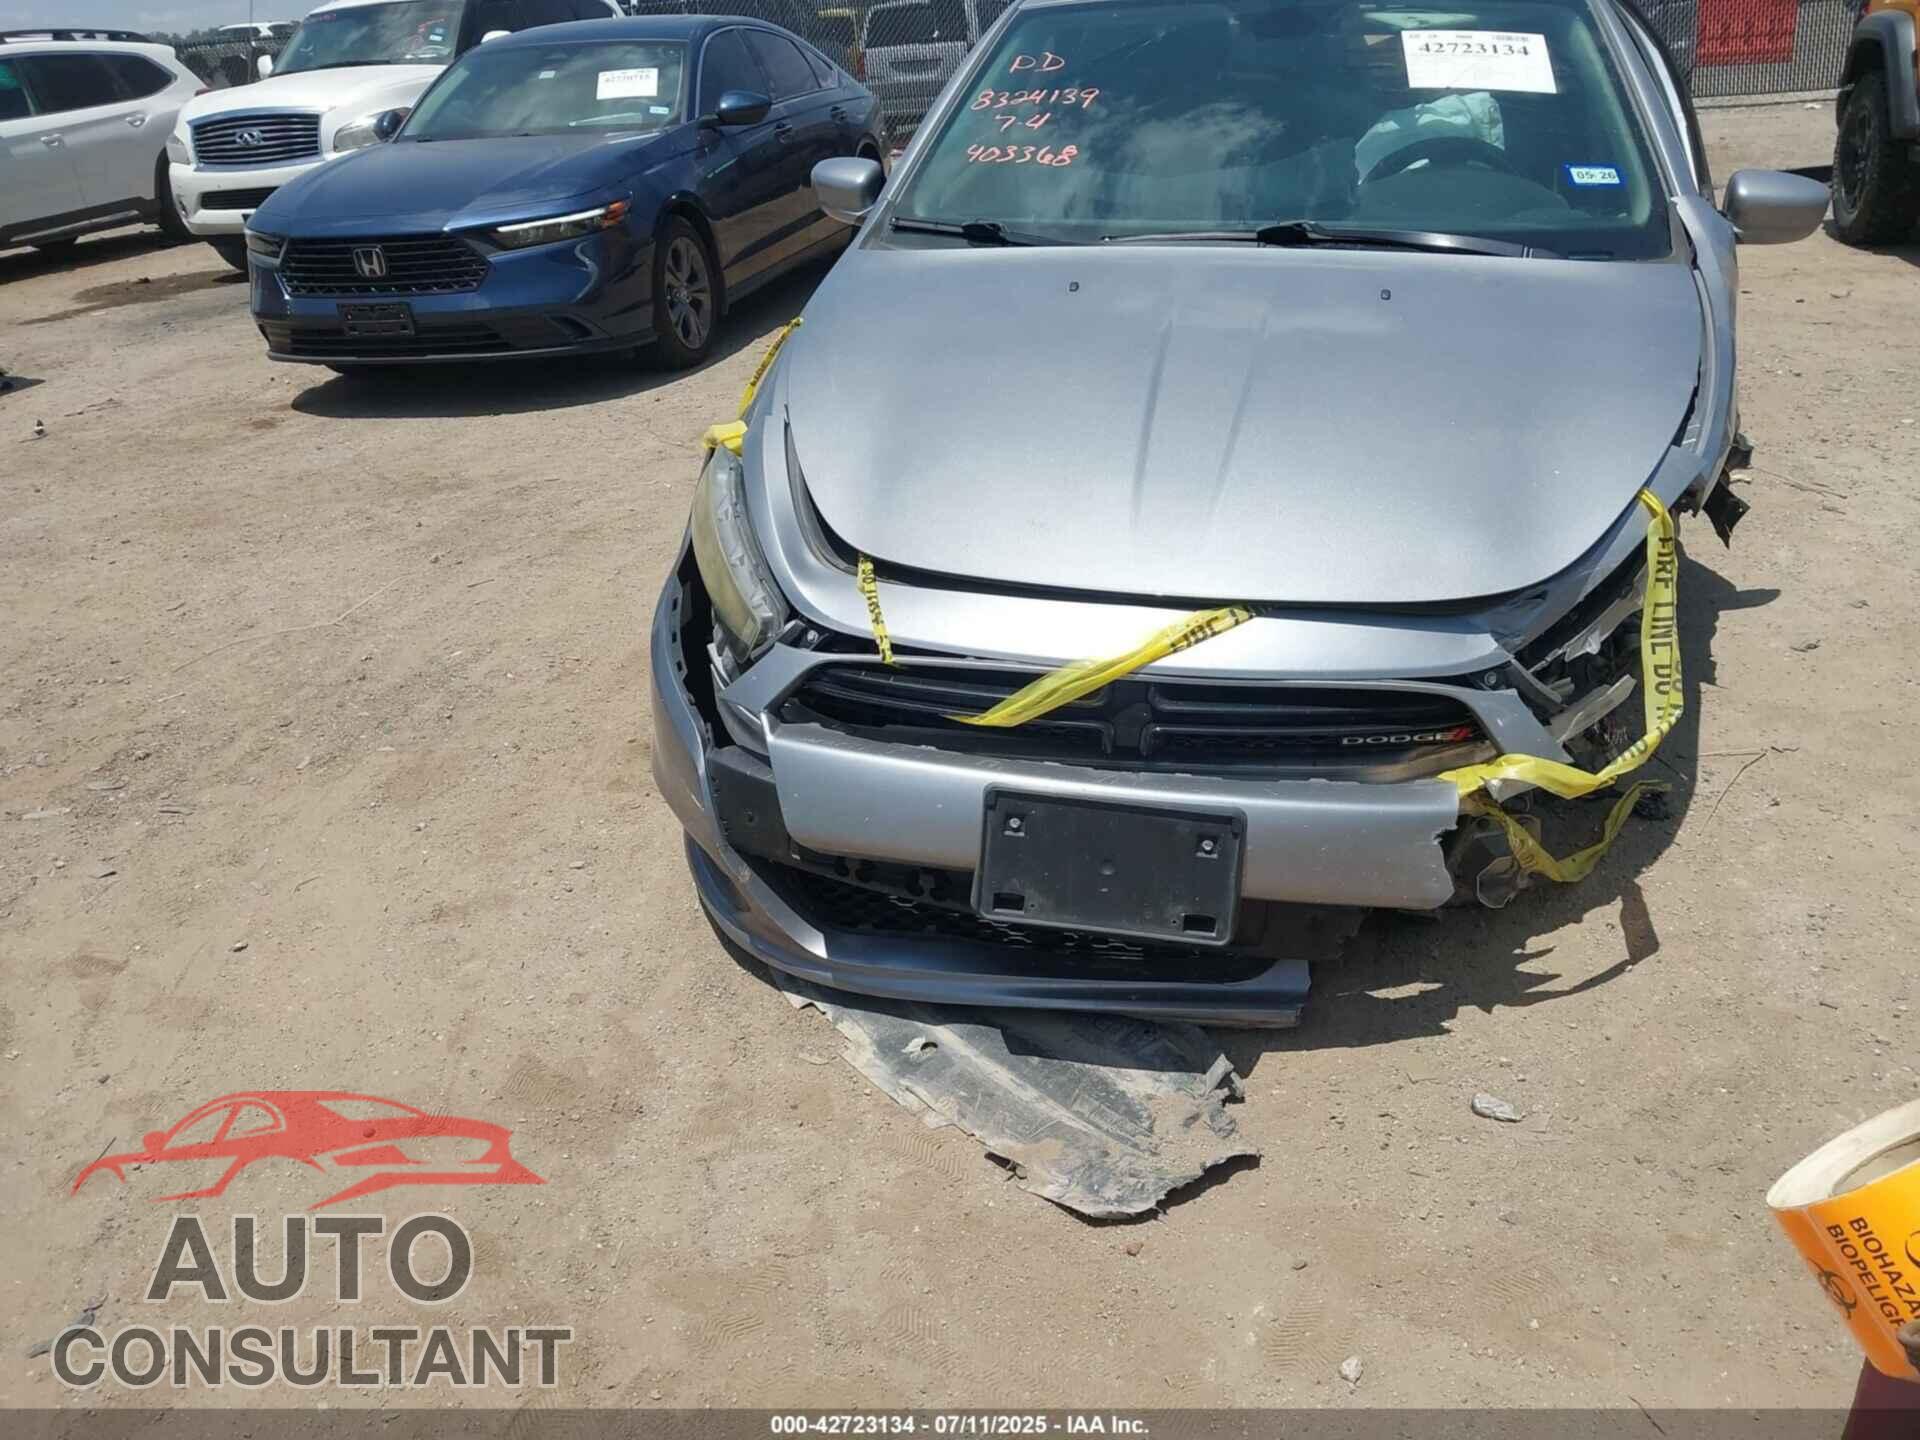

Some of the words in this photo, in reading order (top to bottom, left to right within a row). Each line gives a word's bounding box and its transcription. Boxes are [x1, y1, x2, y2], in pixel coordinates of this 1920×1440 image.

[1418, 42, 1530, 57] 42723134
[970, 87, 1100, 110] 8324139
[1342, 733, 1450, 745] DODGE
